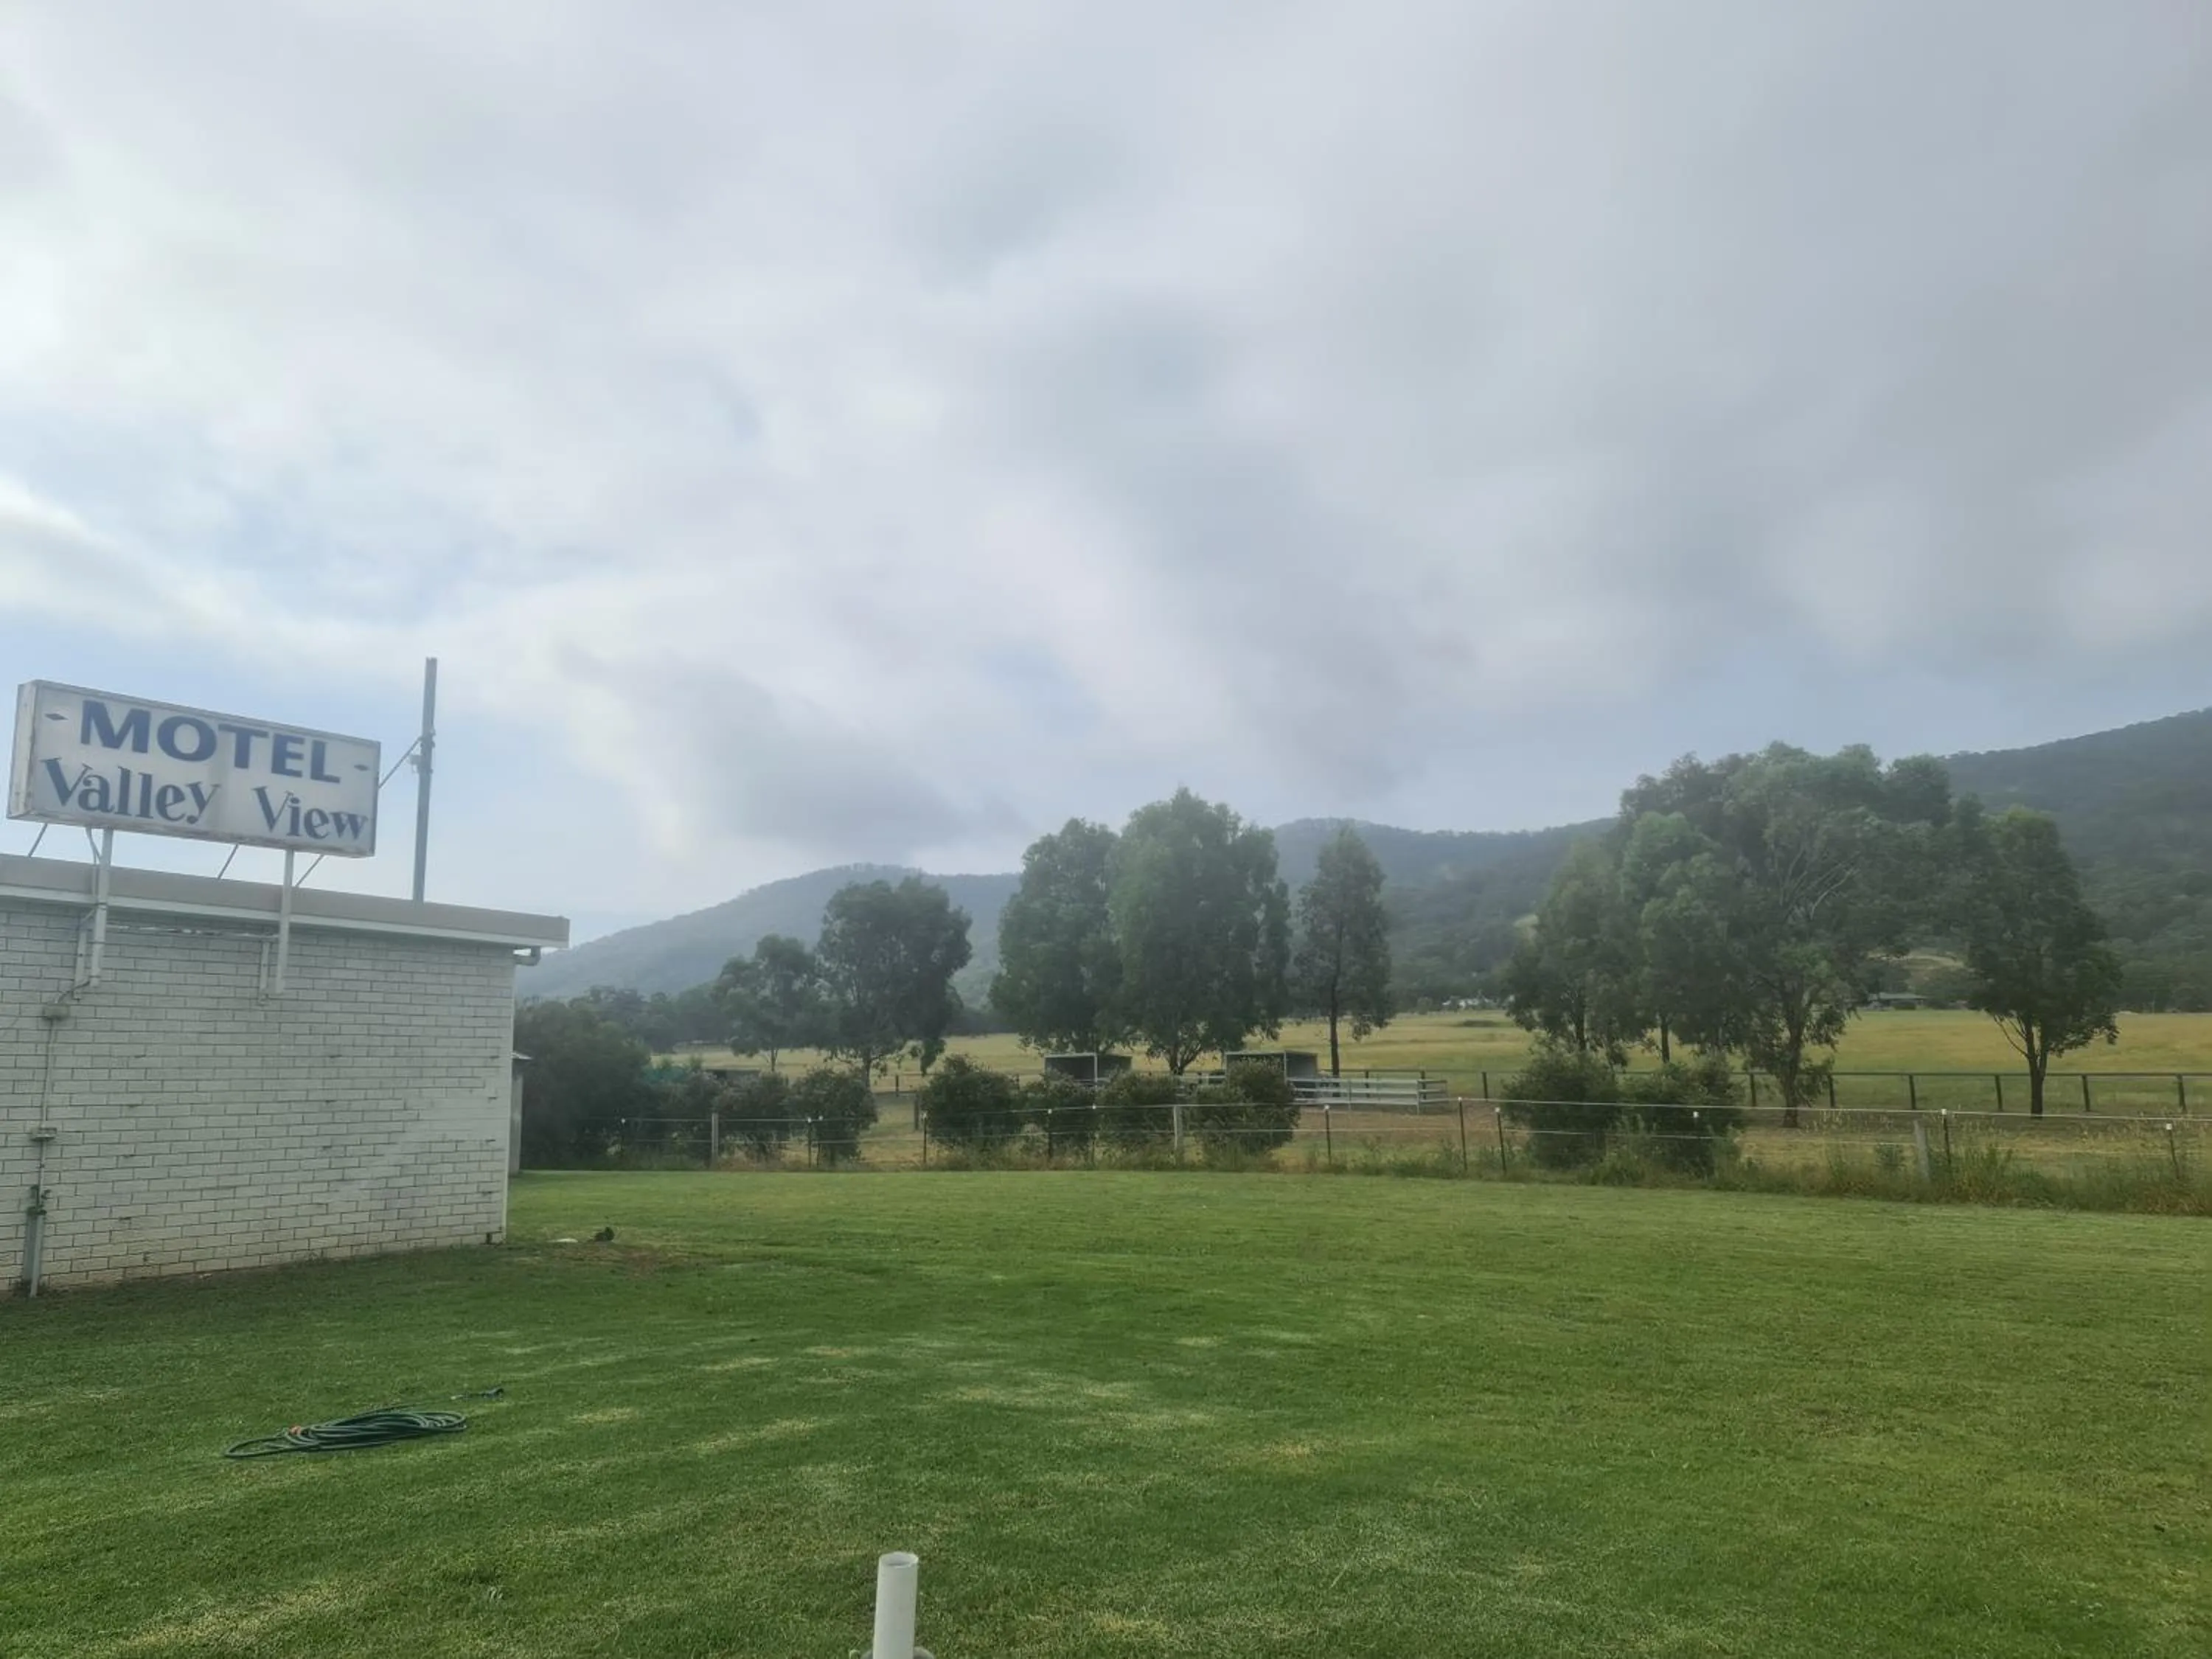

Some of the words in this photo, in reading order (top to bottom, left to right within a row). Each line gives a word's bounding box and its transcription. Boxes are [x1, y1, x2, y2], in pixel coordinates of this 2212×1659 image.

[80, 699, 341, 784] MOTEL
[39, 757, 223, 824] Valley
[254, 786, 369, 841] View
